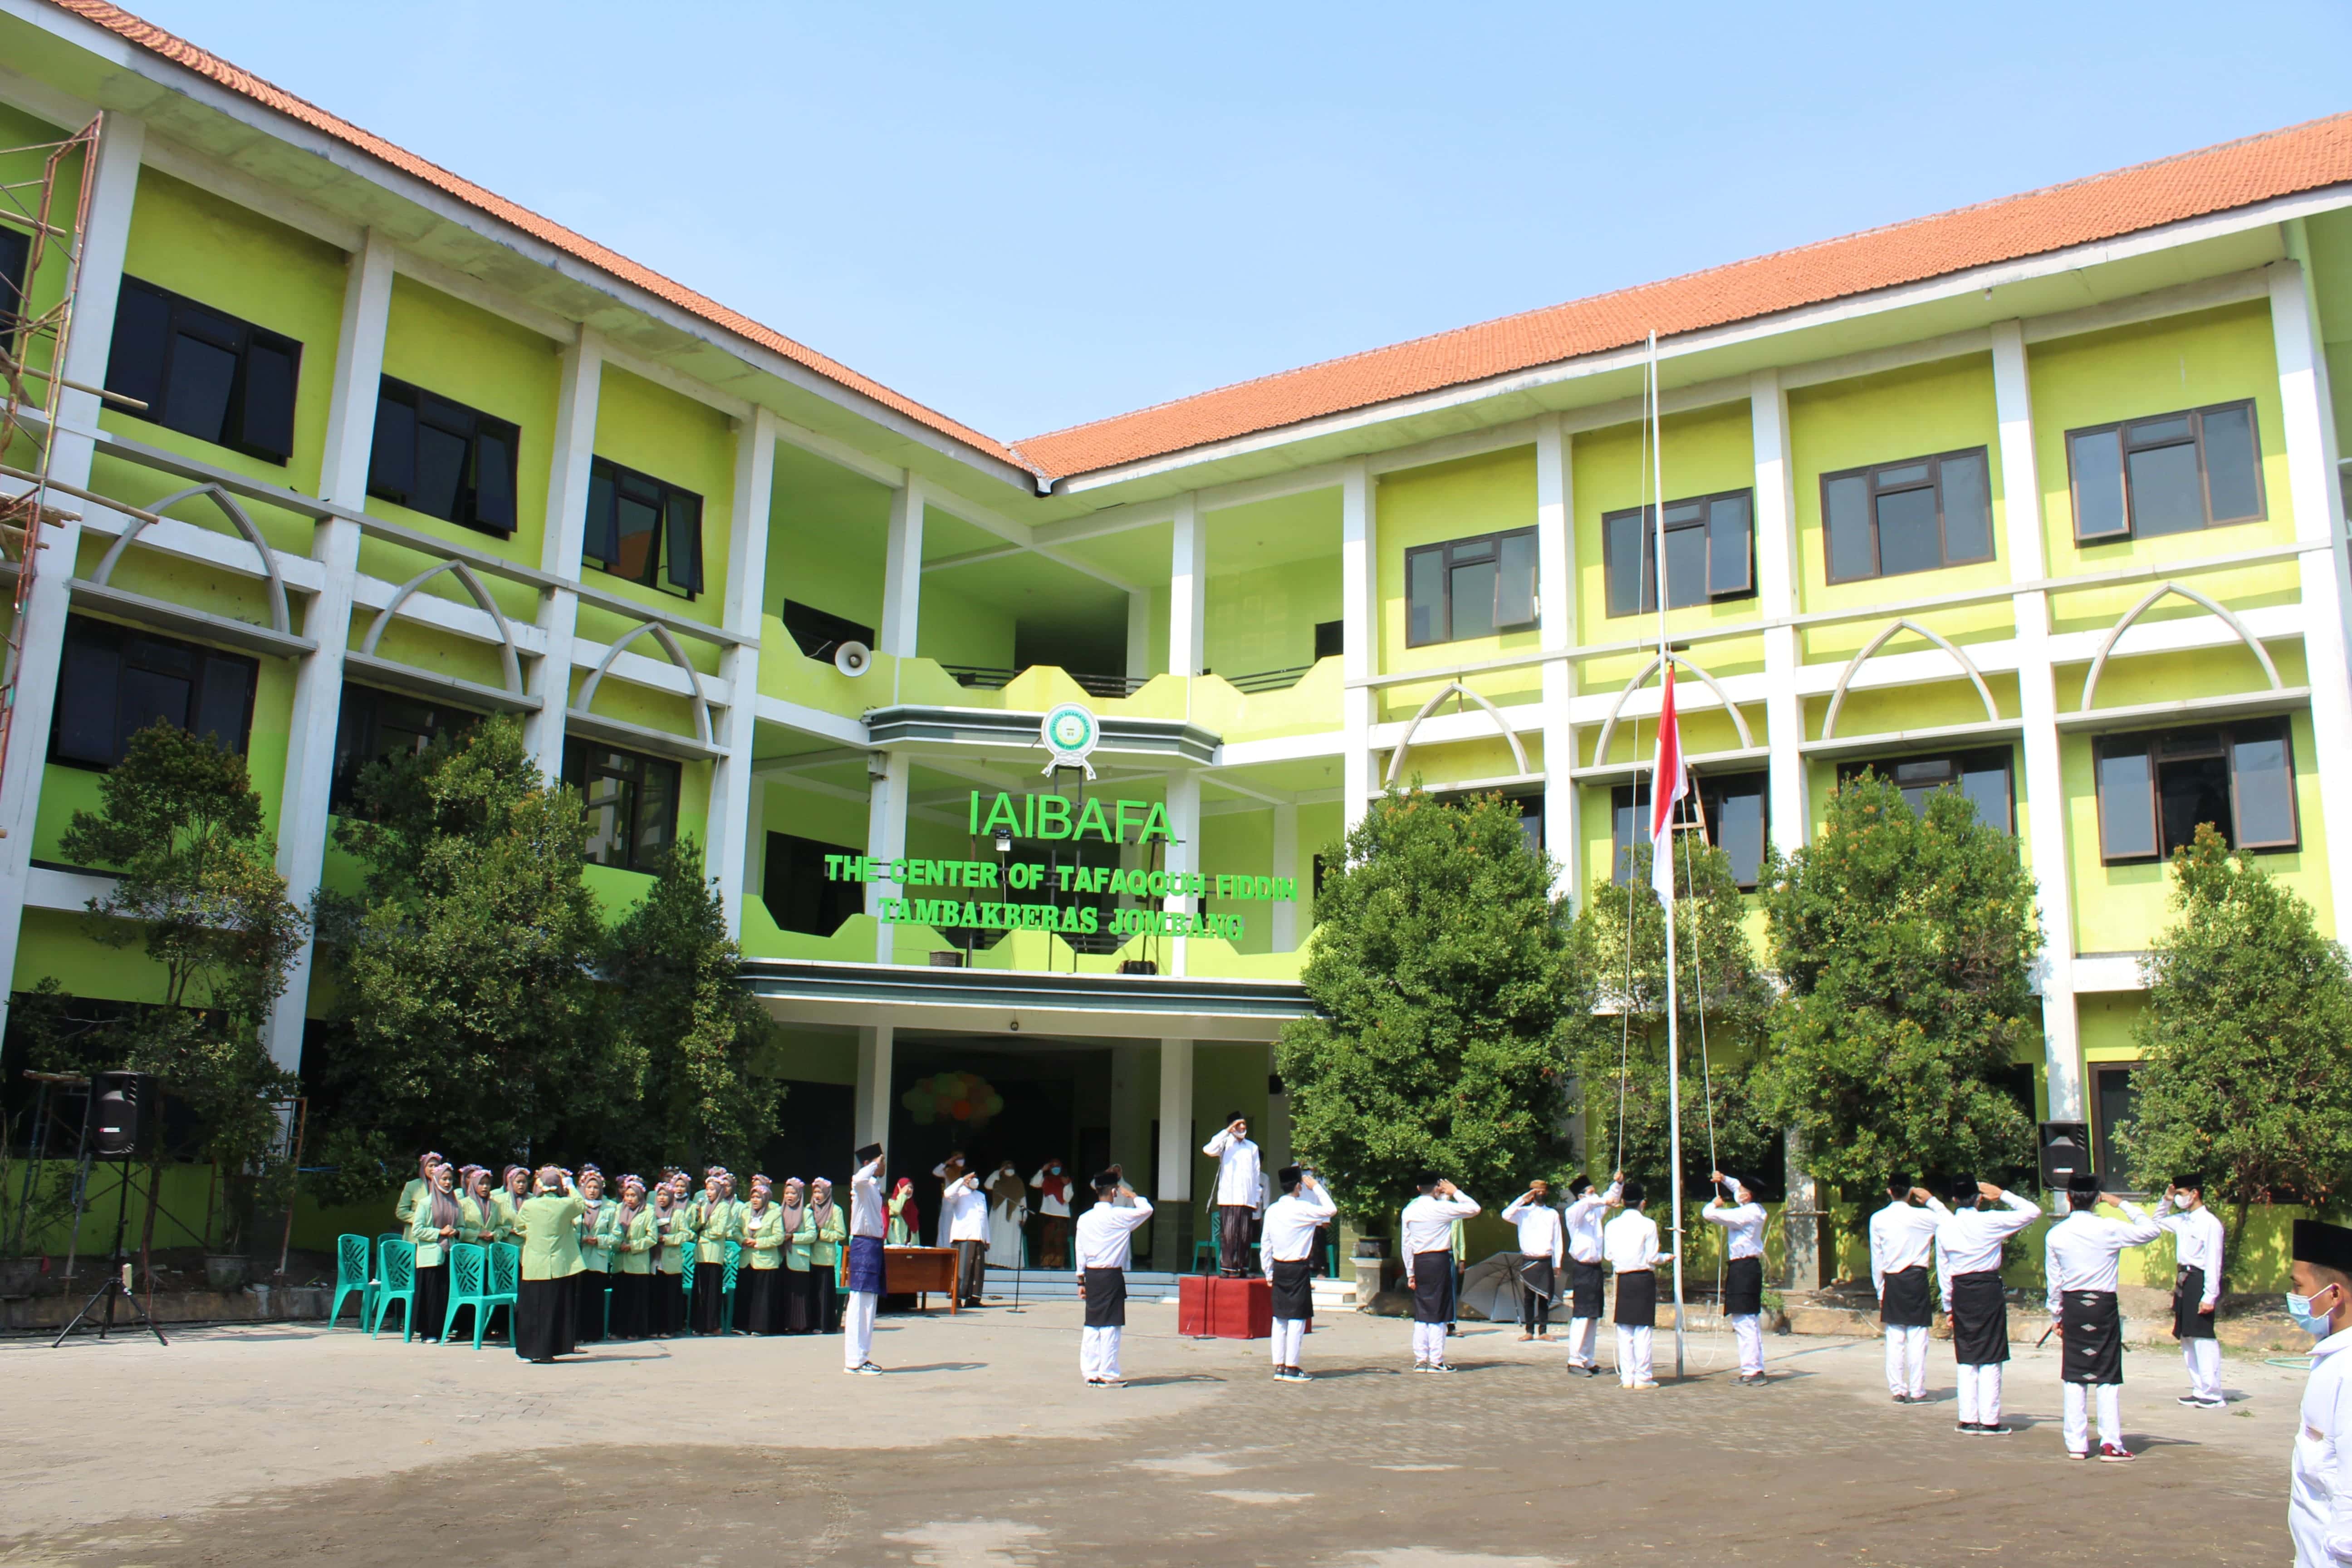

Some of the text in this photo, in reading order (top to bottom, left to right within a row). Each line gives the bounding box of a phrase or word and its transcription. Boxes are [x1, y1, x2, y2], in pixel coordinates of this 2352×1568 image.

[970, 790, 1177, 846] IAIBAFA
[825, 855, 1298, 902] THE CENTER OF TAFAQQUH FIDDIN
[878, 897, 1245, 941] TAMBAKBERAS JOMBANG
